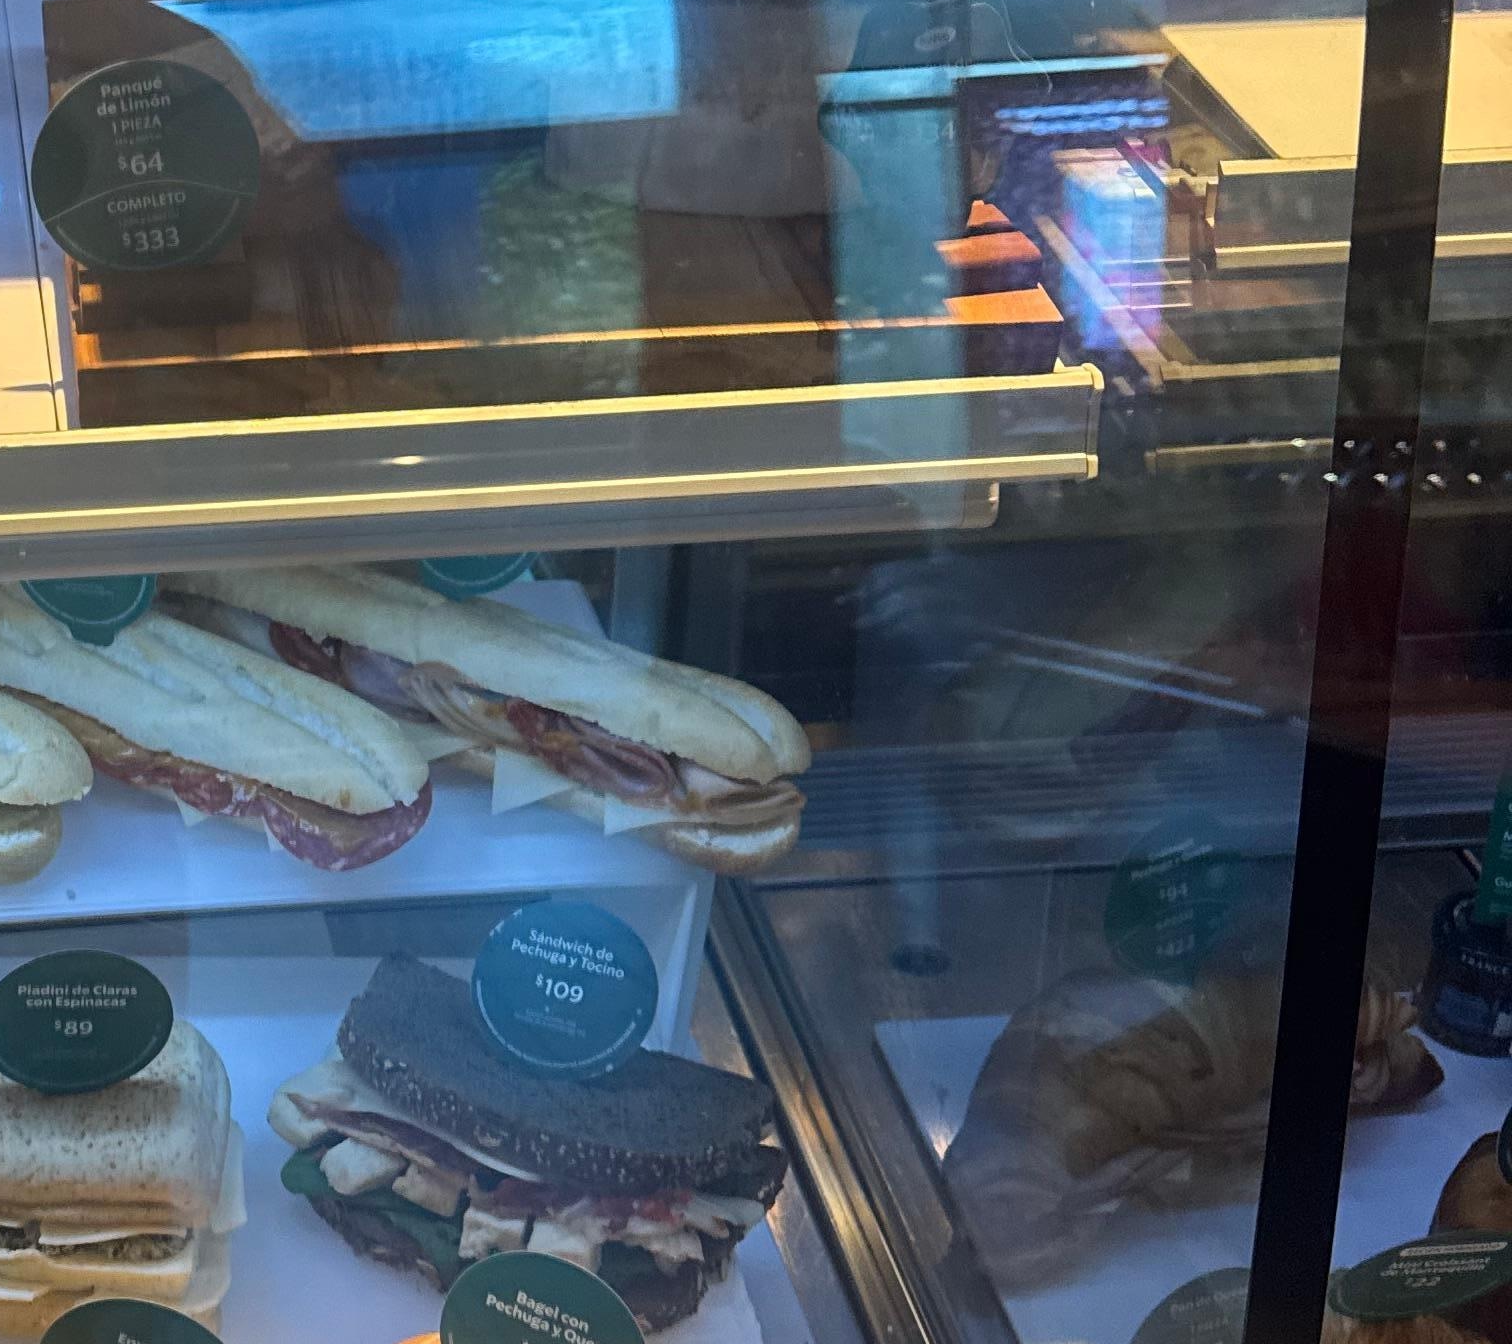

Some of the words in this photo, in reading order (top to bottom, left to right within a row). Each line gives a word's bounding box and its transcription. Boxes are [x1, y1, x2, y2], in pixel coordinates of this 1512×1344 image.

[100, 77, 163, 98] Panqué
[96, 104, 117, 117] de
[120, 94, 171, 113] Limón
[121, 117, 162, 132] PIEZA
[117, 151, 164, 175] $64
[107, 191, 187, 213] COMPLETO
[122, 227, 180, 253] $333
[529, 928, 594, 957] Sándwich
[596, 947, 614, 962] de
[511, 938, 567, 965] Pechuga
[569, 957, 578, 968] y
[581, 957, 625, 979] Tocino
[17, 984, 70, 997] Piadini
[72, 984, 91, 996] de
[92, 984, 139, 997] Claras
[536, 973, 584, 1003] $109
[26, 998, 52, 1008] con
[54, 996, 127, 1009] Espinacas
[485, 1293, 550, 1331] Pechuga
[551, 1324, 561, 1338] y
[516, 1290, 559, 1320] Bagel
[561, 1312, 590, 1333] con
